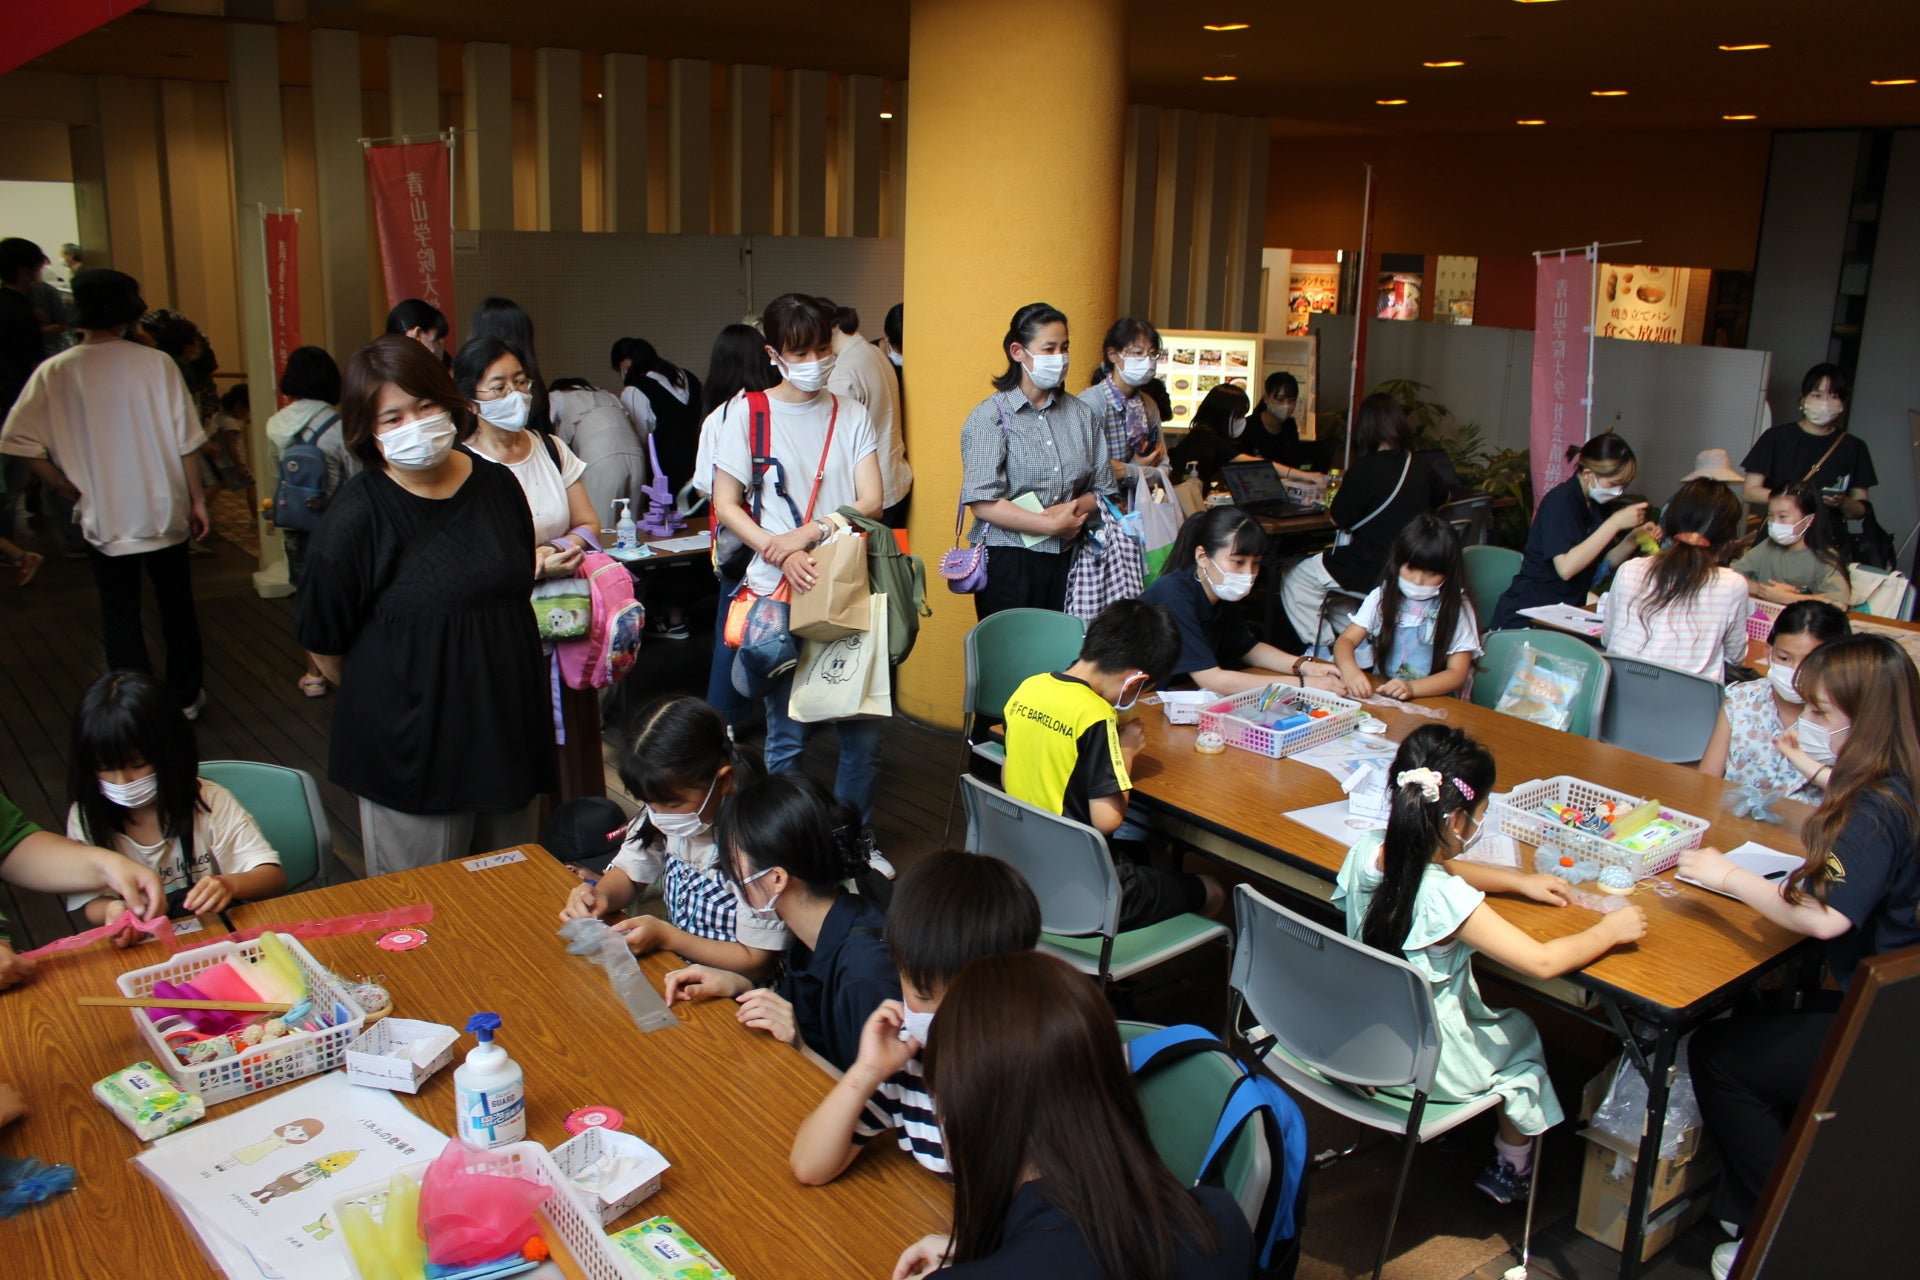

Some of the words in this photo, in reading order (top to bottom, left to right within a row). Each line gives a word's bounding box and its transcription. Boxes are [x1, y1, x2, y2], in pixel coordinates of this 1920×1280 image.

[1016, 704, 1028, 717] FC
[1027, 708, 1074, 739] BARCELONA
[491, 1094, 516, 1107] GUARD
[356, 1118, 417, 1156] パネルの登場者
